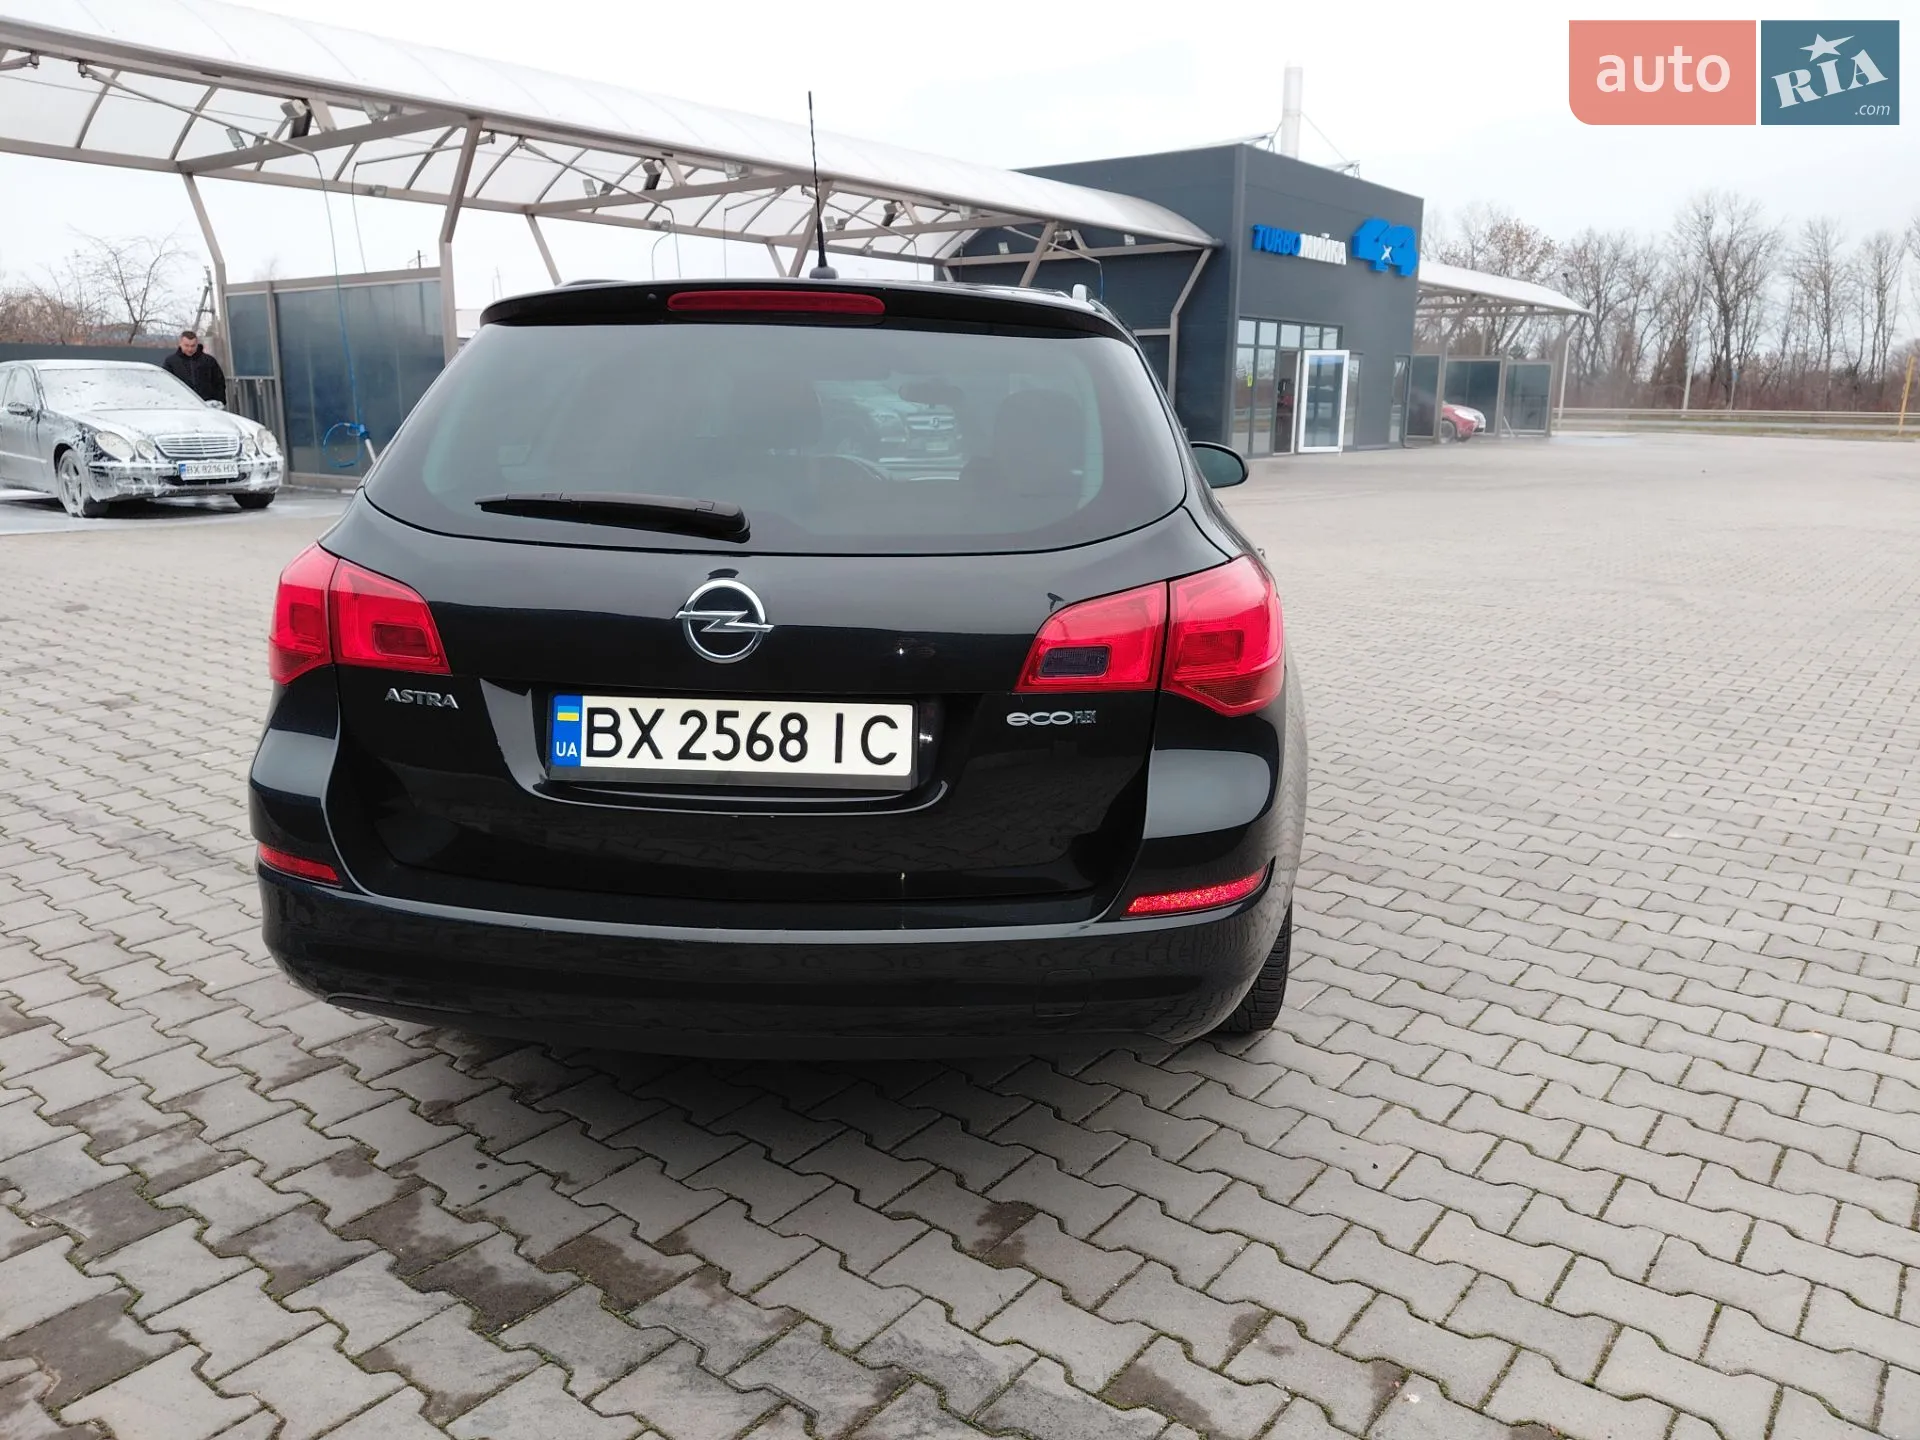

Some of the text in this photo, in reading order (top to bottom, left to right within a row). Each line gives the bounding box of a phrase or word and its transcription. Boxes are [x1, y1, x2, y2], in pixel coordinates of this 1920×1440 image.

[384, 687, 459, 710] ASTRA
[585, 707, 665, 760] BX
[677, 709, 809, 764] 2568
[555, 741, 578, 758] UA
